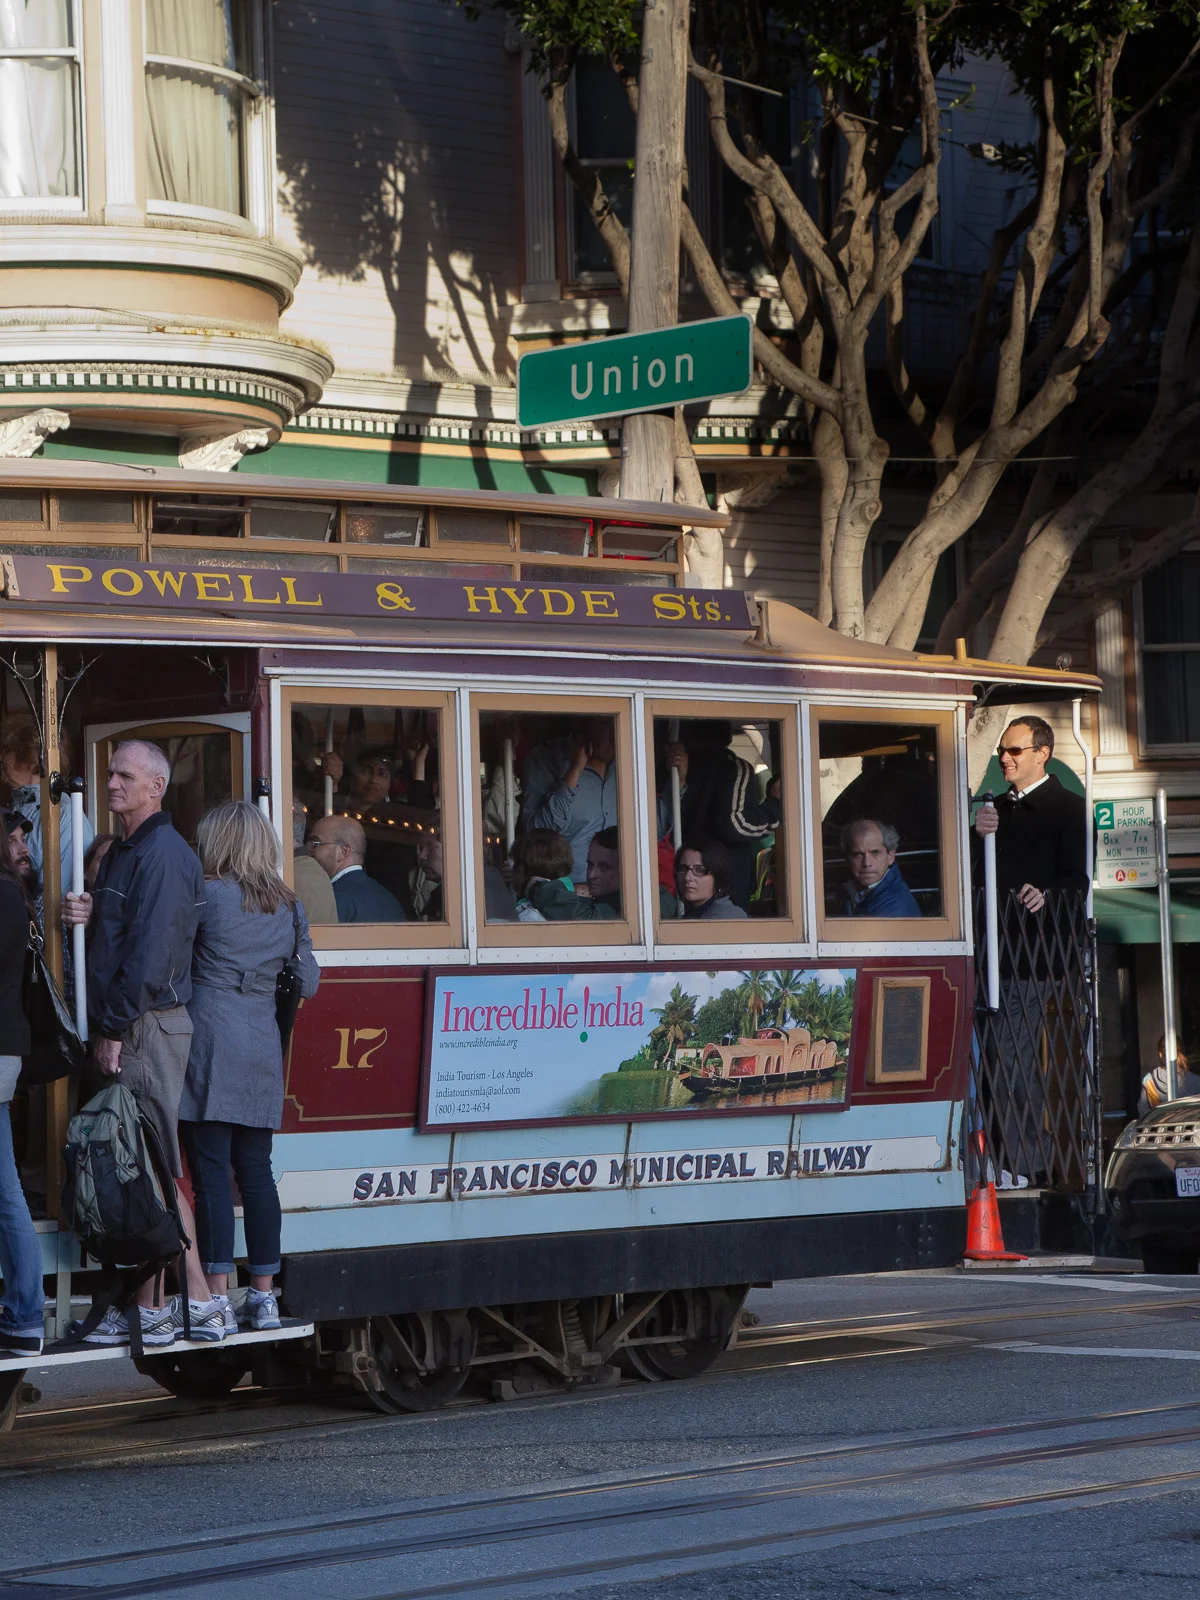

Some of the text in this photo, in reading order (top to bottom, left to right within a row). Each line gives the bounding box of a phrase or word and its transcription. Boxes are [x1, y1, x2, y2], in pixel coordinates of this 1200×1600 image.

[571, 353, 694, 400] Union
[46, 564, 732, 622] POWELL & HYDE Sts.
[1099, 807, 1111, 825] 2
[1123, 807, 1145, 816] HOUR
[1117, 817, 1152, 827] PARKING
[1106, 847, 1122, 857] MON
[1136, 846, 1148, 855] FRI
[440, 987, 579, 1032] Incredible
[332, 1027, 388, 1068] 17
[439, 1037, 518, 1049] www.incredibleindia.org
[437, 1071, 455, 1082] India
[457, 1070, 486, 1081] Tourism
[492, 1069, 505, 1080] Los
[506, 1069, 534, 1081] Angeles
[435, 1086, 521, 1098] indiatourismla@aol.com
[435, 1103, 491, 1117] (800) 422-4634
[354, 1145, 873, 1200] SAN FRANCISCO MUNICIPAL RAILWAY
